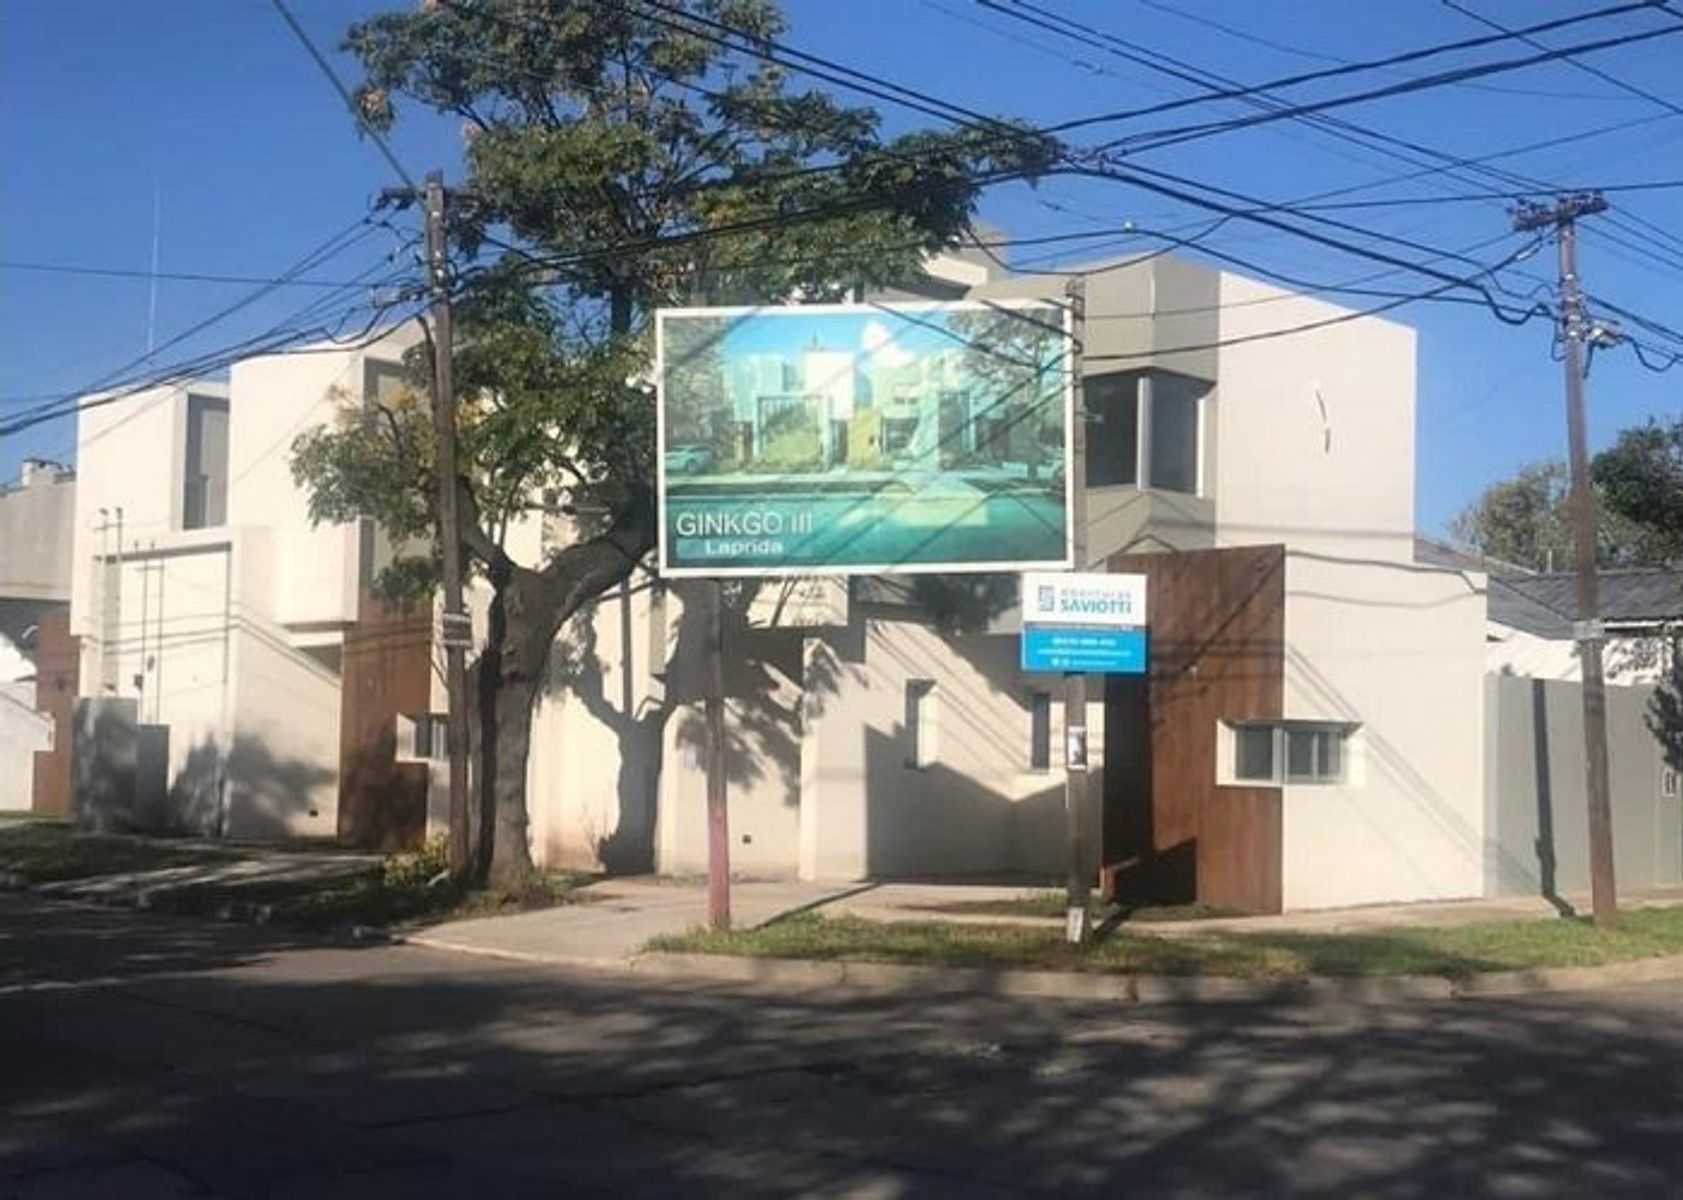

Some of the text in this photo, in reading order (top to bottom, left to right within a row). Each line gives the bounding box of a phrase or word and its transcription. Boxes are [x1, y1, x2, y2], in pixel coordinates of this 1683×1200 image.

[676, 511, 783, 536] GINKGO
[705, 540, 783, 556] Laprida
[1060, 599, 1132, 613] SAVIOTTI
